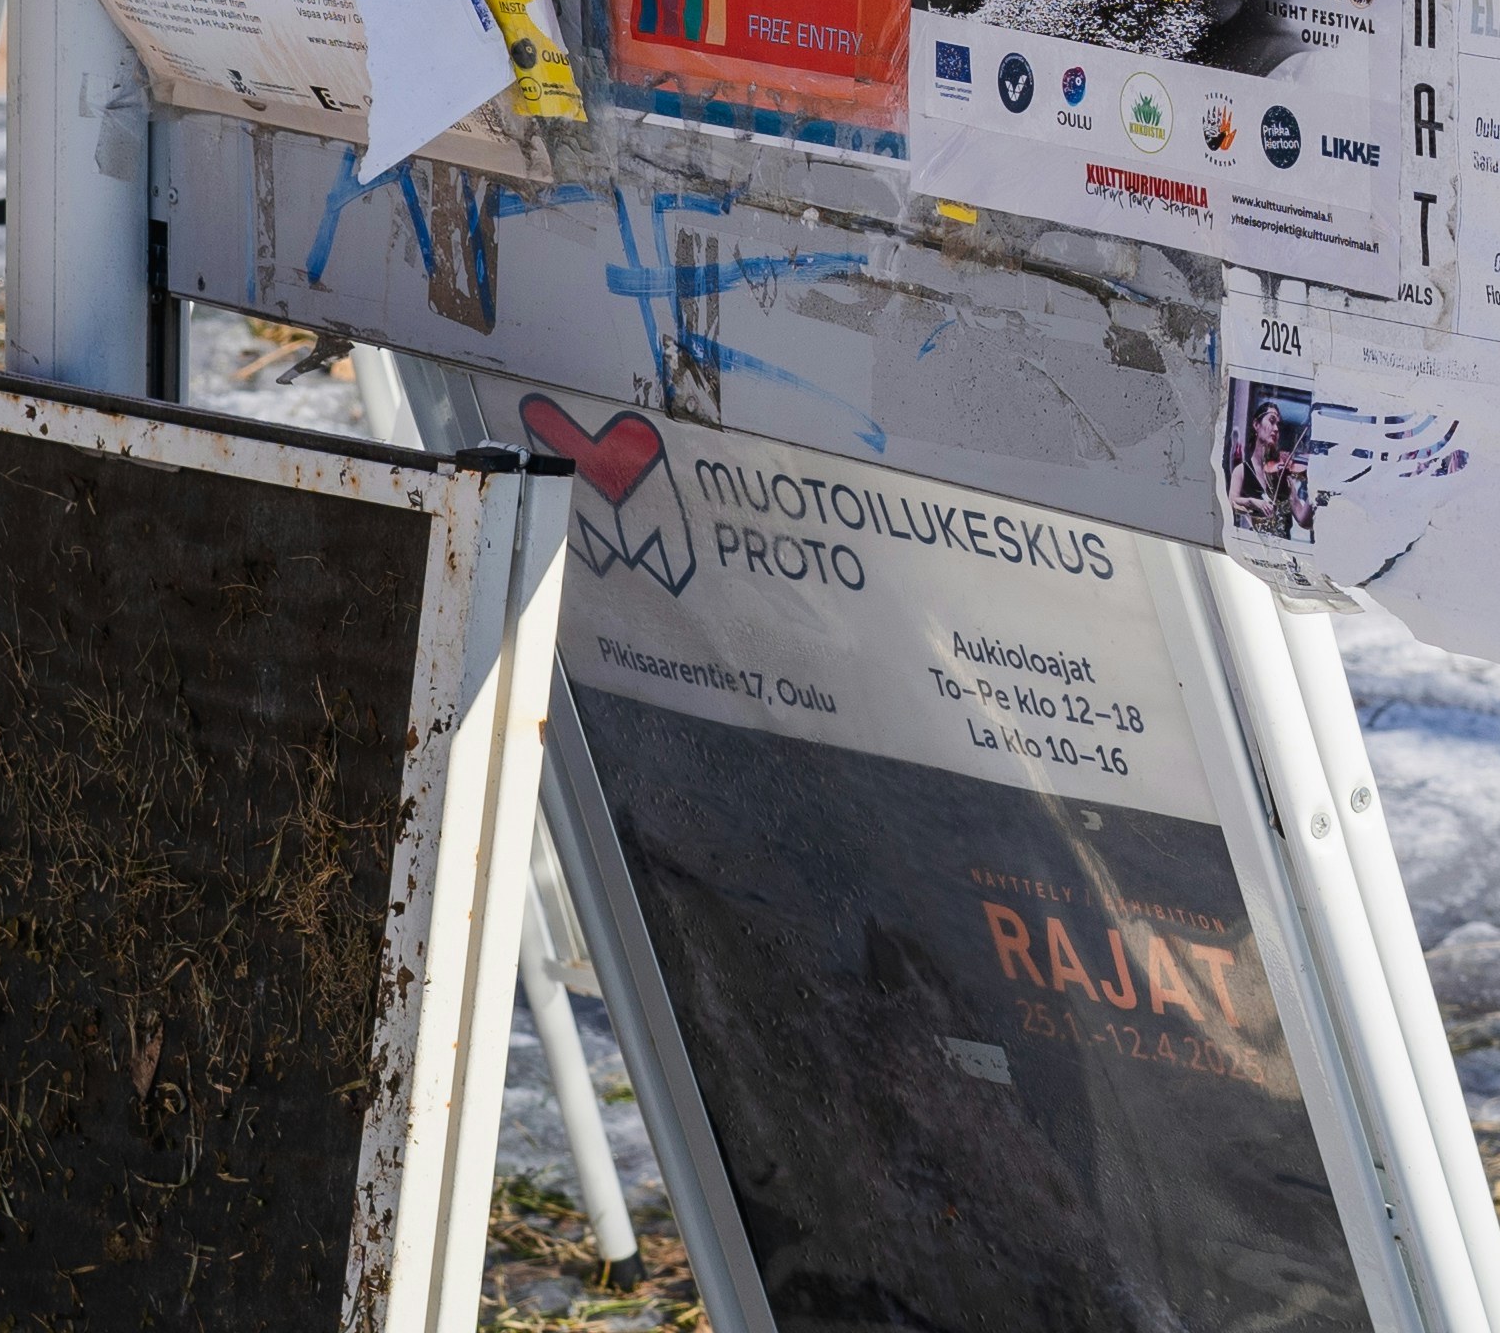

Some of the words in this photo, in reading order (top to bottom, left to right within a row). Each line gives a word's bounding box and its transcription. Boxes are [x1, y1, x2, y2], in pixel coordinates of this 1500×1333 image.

[748, 14, 792, 44] FREE
[797, 23, 865, 56] ENTRY
[1321, 135, 1380, 167] LIKKE
[1086, 162, 1209, 209] KULTTUURIVOIMALA
[1259, 318, 1302, 358] 2024
[694, 458, 1115, 581] MUOTOILUKESKUS
[713, 522, 866, 591] PROTO
[596, 633, 739, 693] Pikisaarentie
[739, 672, 773, 706] 17,
[776, 677, 837, 714] Oulu
[951, 629, 1096, 685] Aukioloajat
[1013, 685, 1057, 720] klo
[967, 718, 999, 750] La
[1005, 726, 1043, 760] klo
[970, 864, 1072, 905] NÄYTTELY
[981, 899, 1241, 1031] RAJAT
